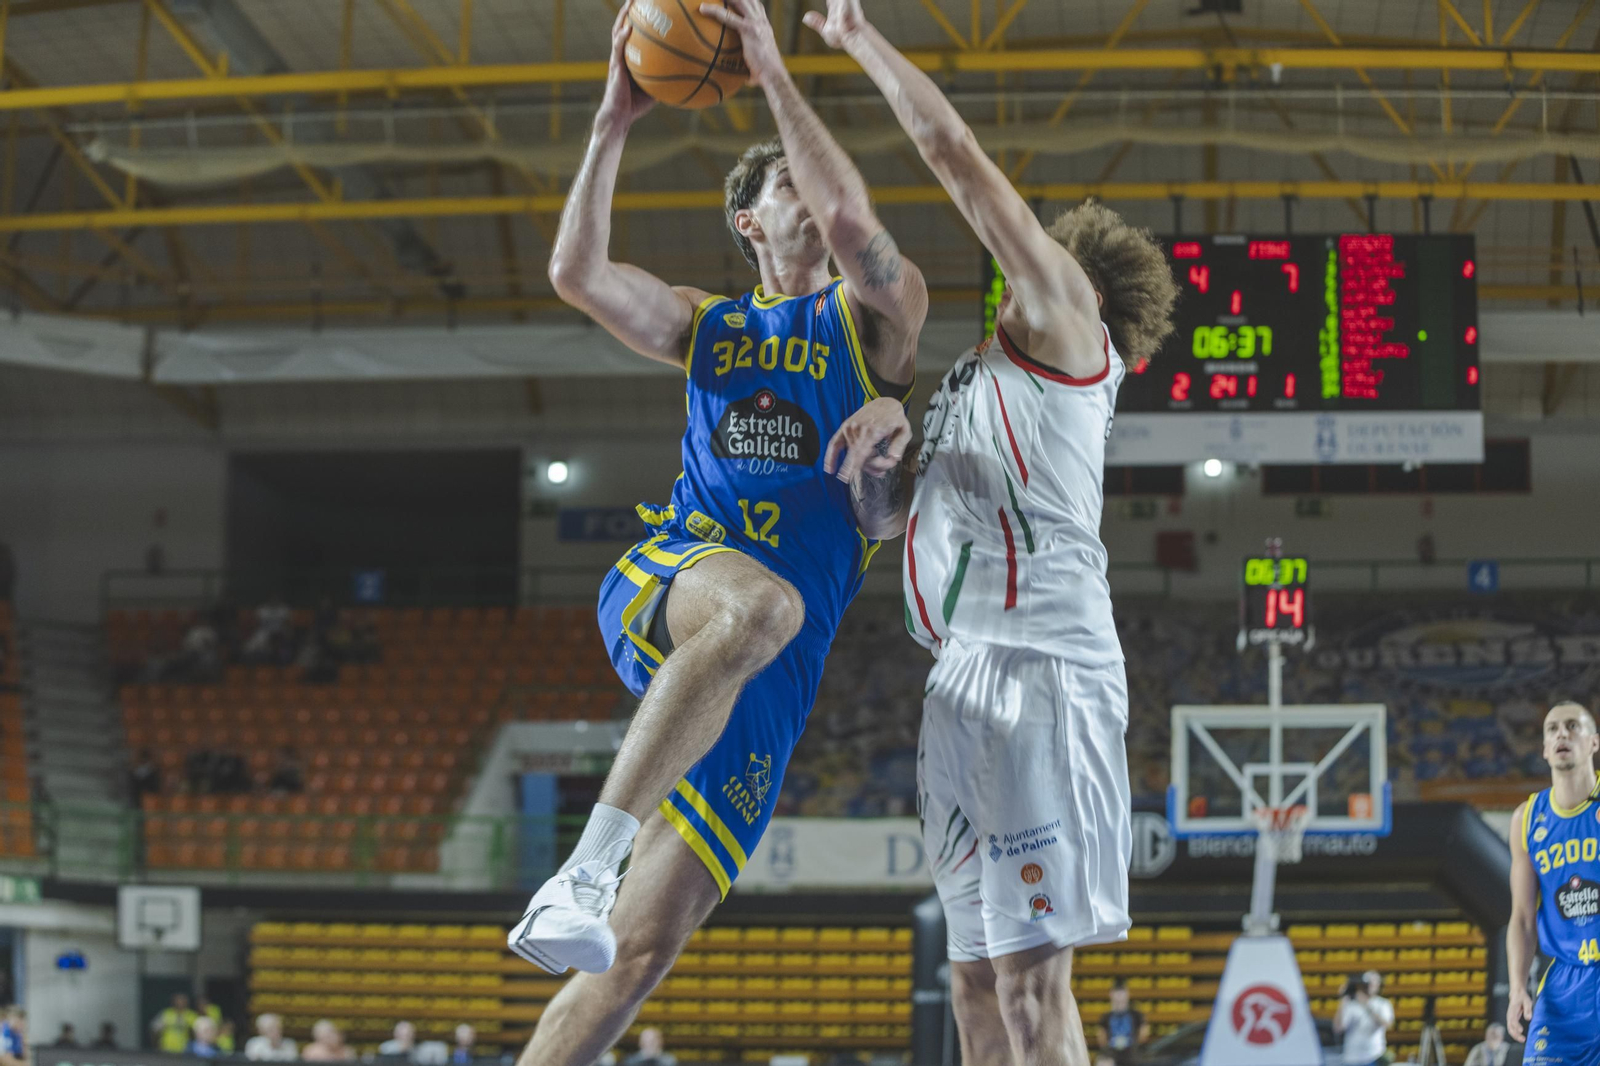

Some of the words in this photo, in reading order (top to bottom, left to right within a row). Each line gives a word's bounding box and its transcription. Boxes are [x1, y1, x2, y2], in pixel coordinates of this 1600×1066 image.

[1188, 264, 1210, 294] 4
[1192, 325, 1273, 359] 06:37
[712, 334, 830, 380] 32005
[726, 410, 804, 439] Estrella
[728, 432, 799, 459] Galicia
[738, 498, 781, 548] 12
[1264, 587, 1304, 629] 14
[1003, 819, 1061, 845] Ajuntament
[1007, 847, 1020, 857] de
[1021, 835, 1058, 853] Palma
[1535, 837, 1600, 874] 3200
[1558, 886, 1599, 906] Estrella
[1563, 901, 1598, 918] Galicia
[1578, 938, 1600, 966] 44
